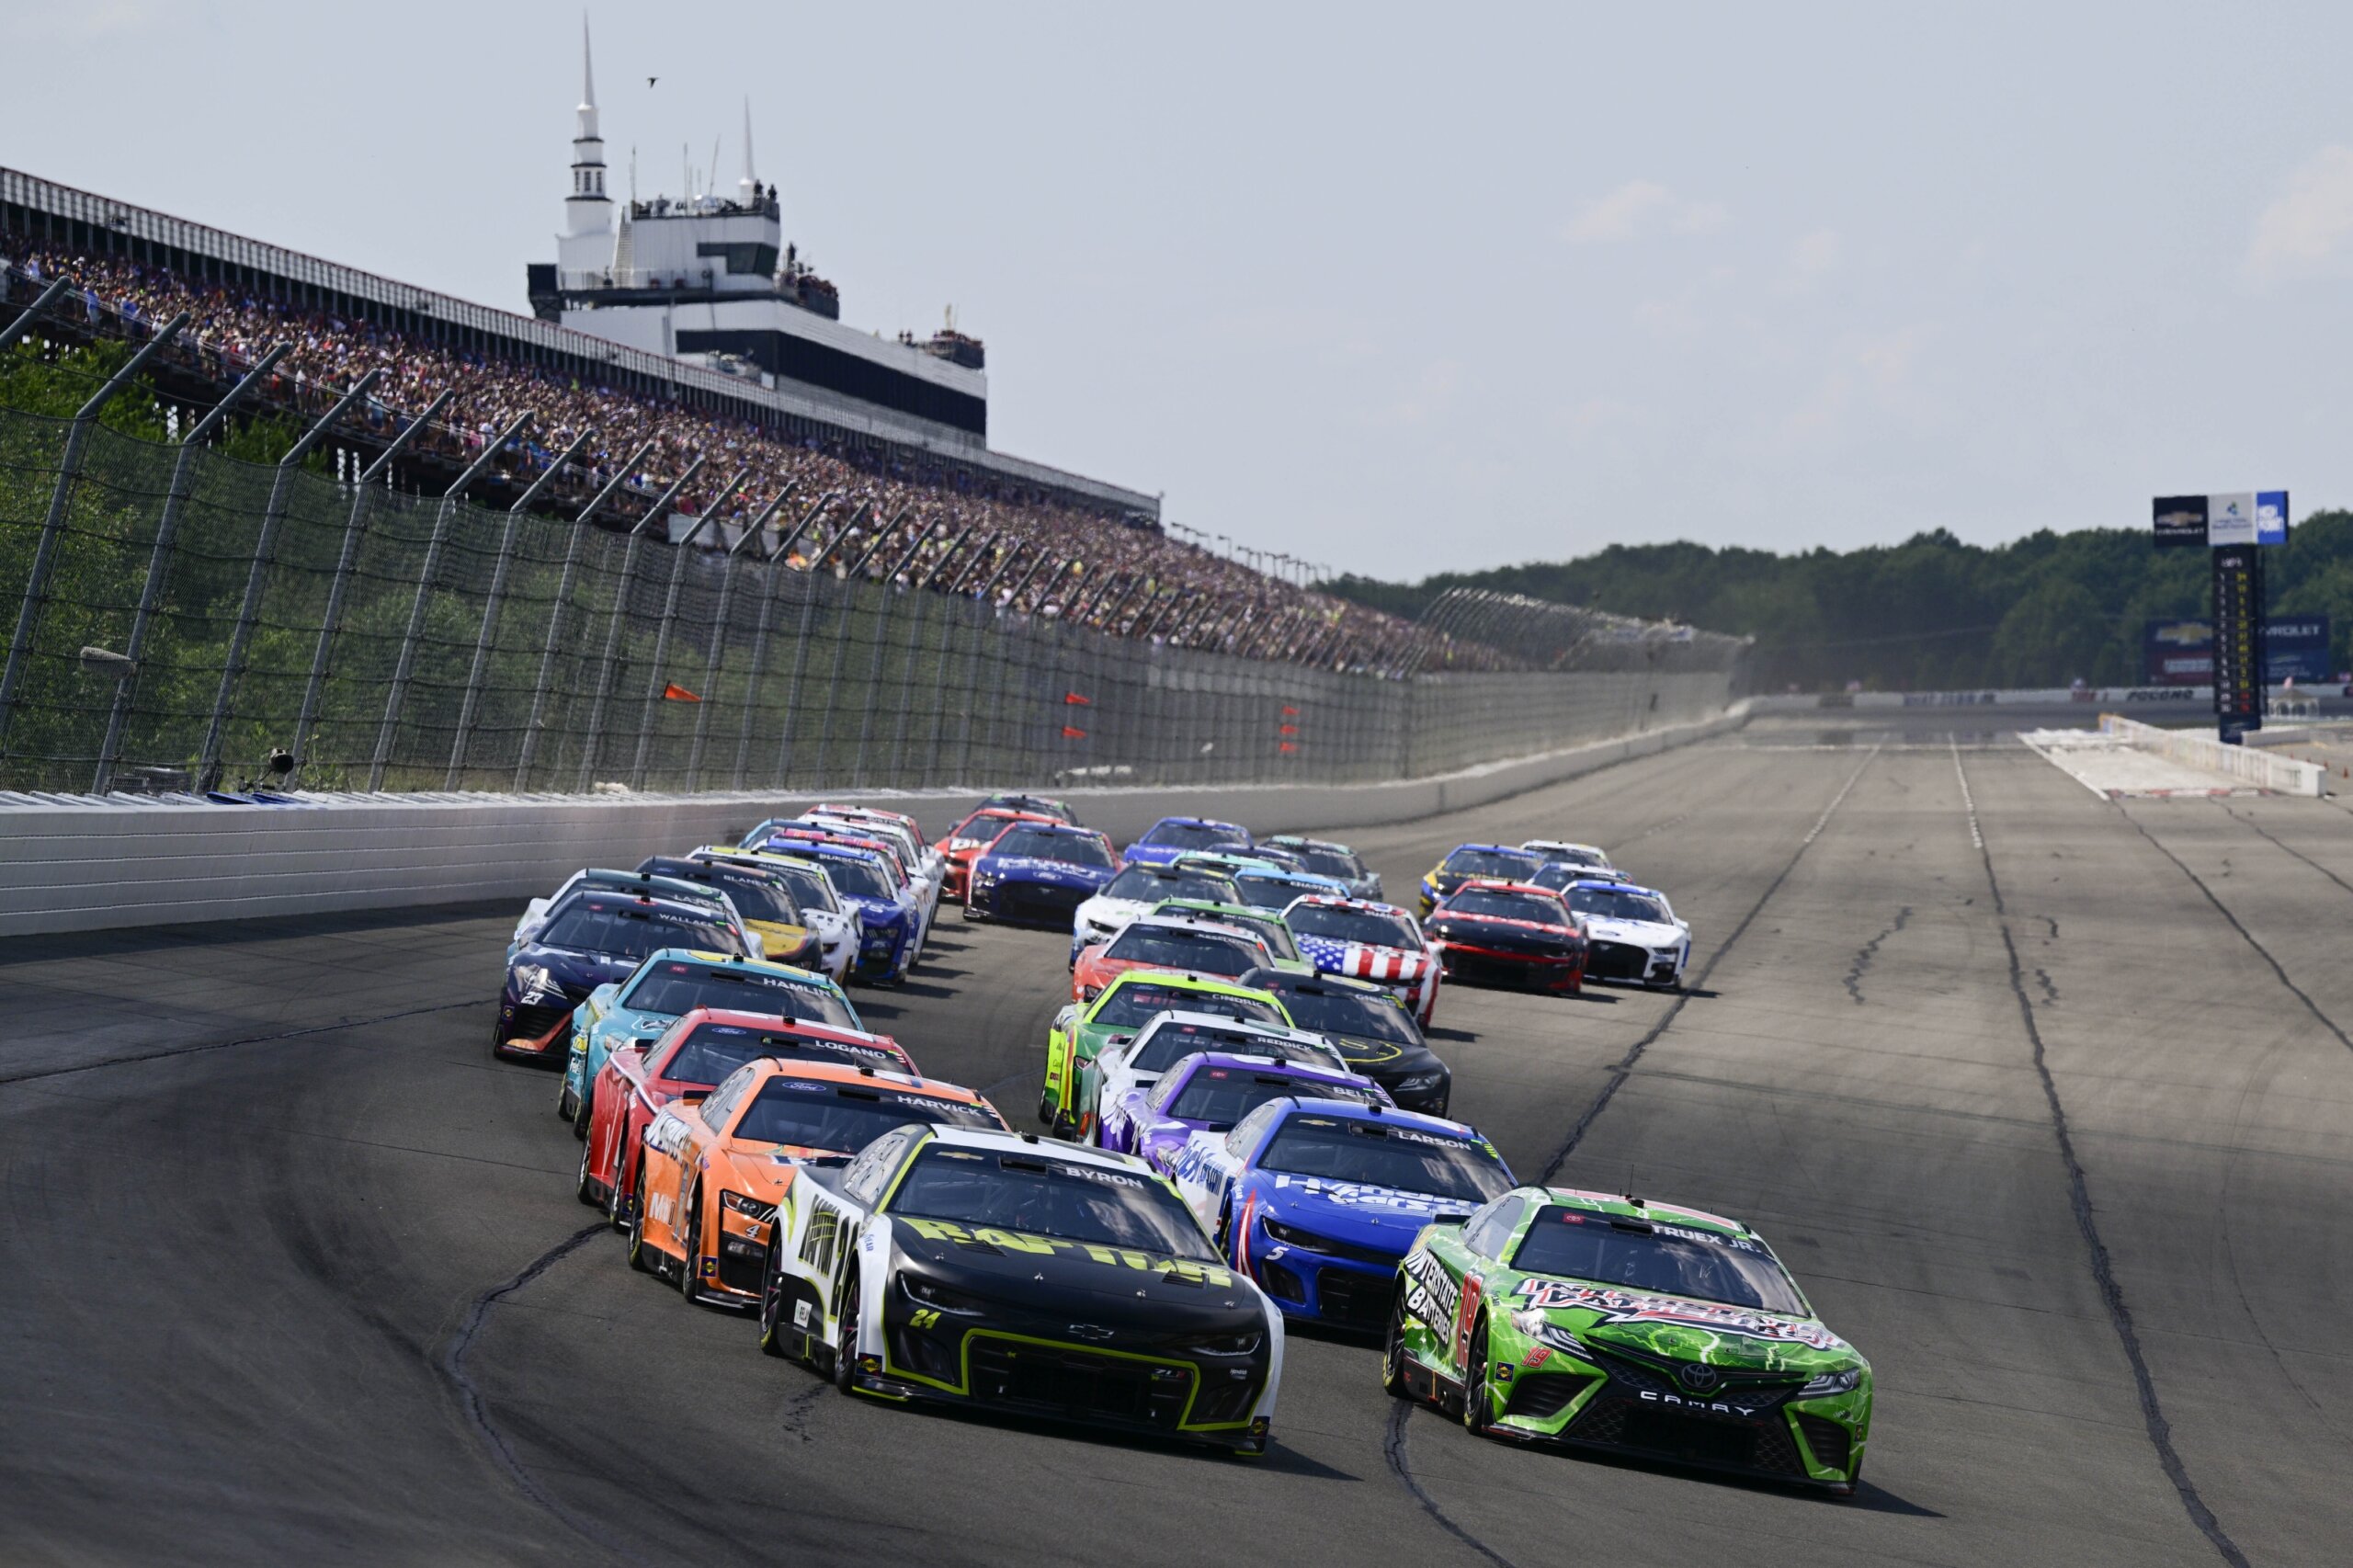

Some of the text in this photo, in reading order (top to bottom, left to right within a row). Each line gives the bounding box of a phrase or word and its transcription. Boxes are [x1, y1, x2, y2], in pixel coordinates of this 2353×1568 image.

[2126, 689, 2194, 701] POCONO
[723, 874, 770, 888] BLANEY
[659, 912, 715, 928] WALLACE
[763, 977, 831, 998] HAMLIN
[521, 991, 544, 1005] 23
[1211, 993, 1265, 1008] CINDRIC
[815, 1040, 887, 1060] LOGANO
[1257, 1036, 1313, 1052] REDDICK
[782, 1081, 826, 1093] Ford
[1333, 1085, 1378, 1102] BELL
[897, 1094, 983, 1117] HARVICK
[1397, 1130, 1472, 1151] LARSON
[1065, 1166, 1144, 1189] BYRON
[745, 1223, 761, 1239] 4
[1653, 1224, 1762, 1255] TRUEX JR.
[1265, 1245, 1290, 1261] 5
[1404, 1246, 1460, 1317] INTERSTATE
[908, 1308, 942, 1330] 24
[1406, 1286, 1451, 1346] BATTERIES
[1521, 1346, 1554, 1369] 19
[1639, 1390, 1756, 1416] CAMRY
